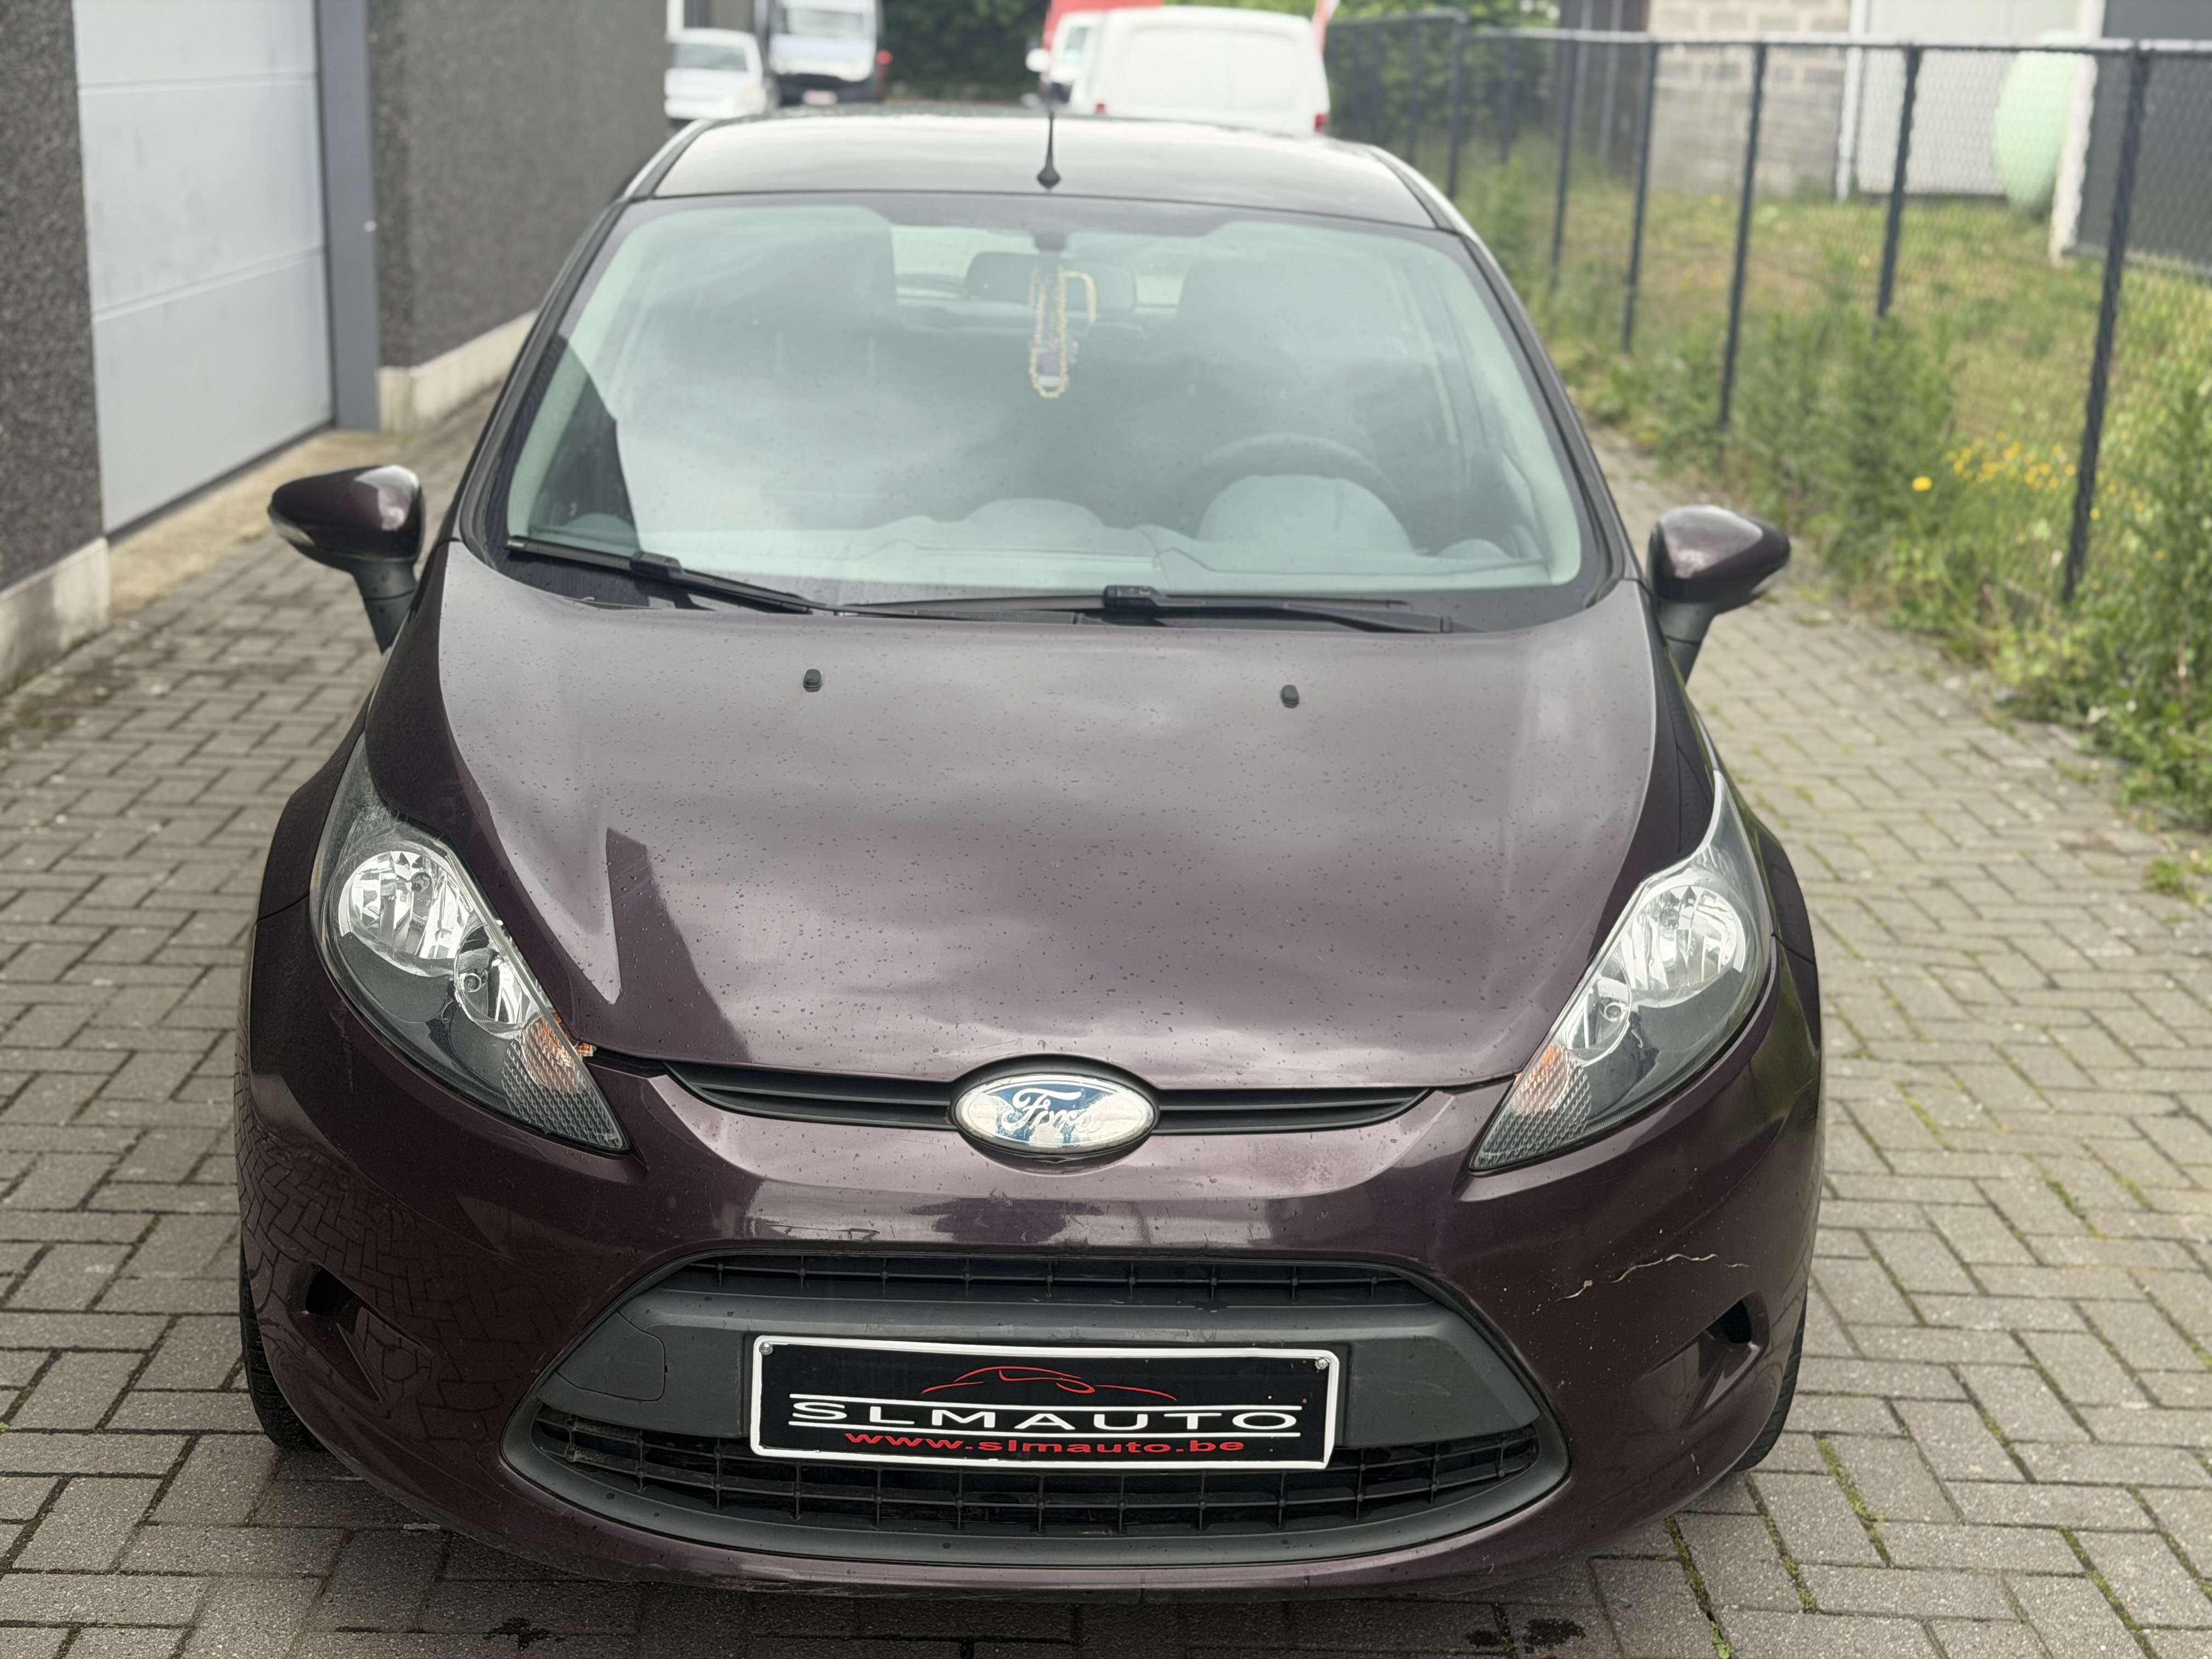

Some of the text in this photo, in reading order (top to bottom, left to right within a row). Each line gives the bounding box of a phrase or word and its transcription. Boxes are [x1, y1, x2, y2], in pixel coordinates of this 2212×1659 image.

[1001, 1088, 1107, 1133] Ford
[792, 1402, 1297, 1430] SLMAUTO
[845, 1432, 1245, 1454] www.slmauto.be
